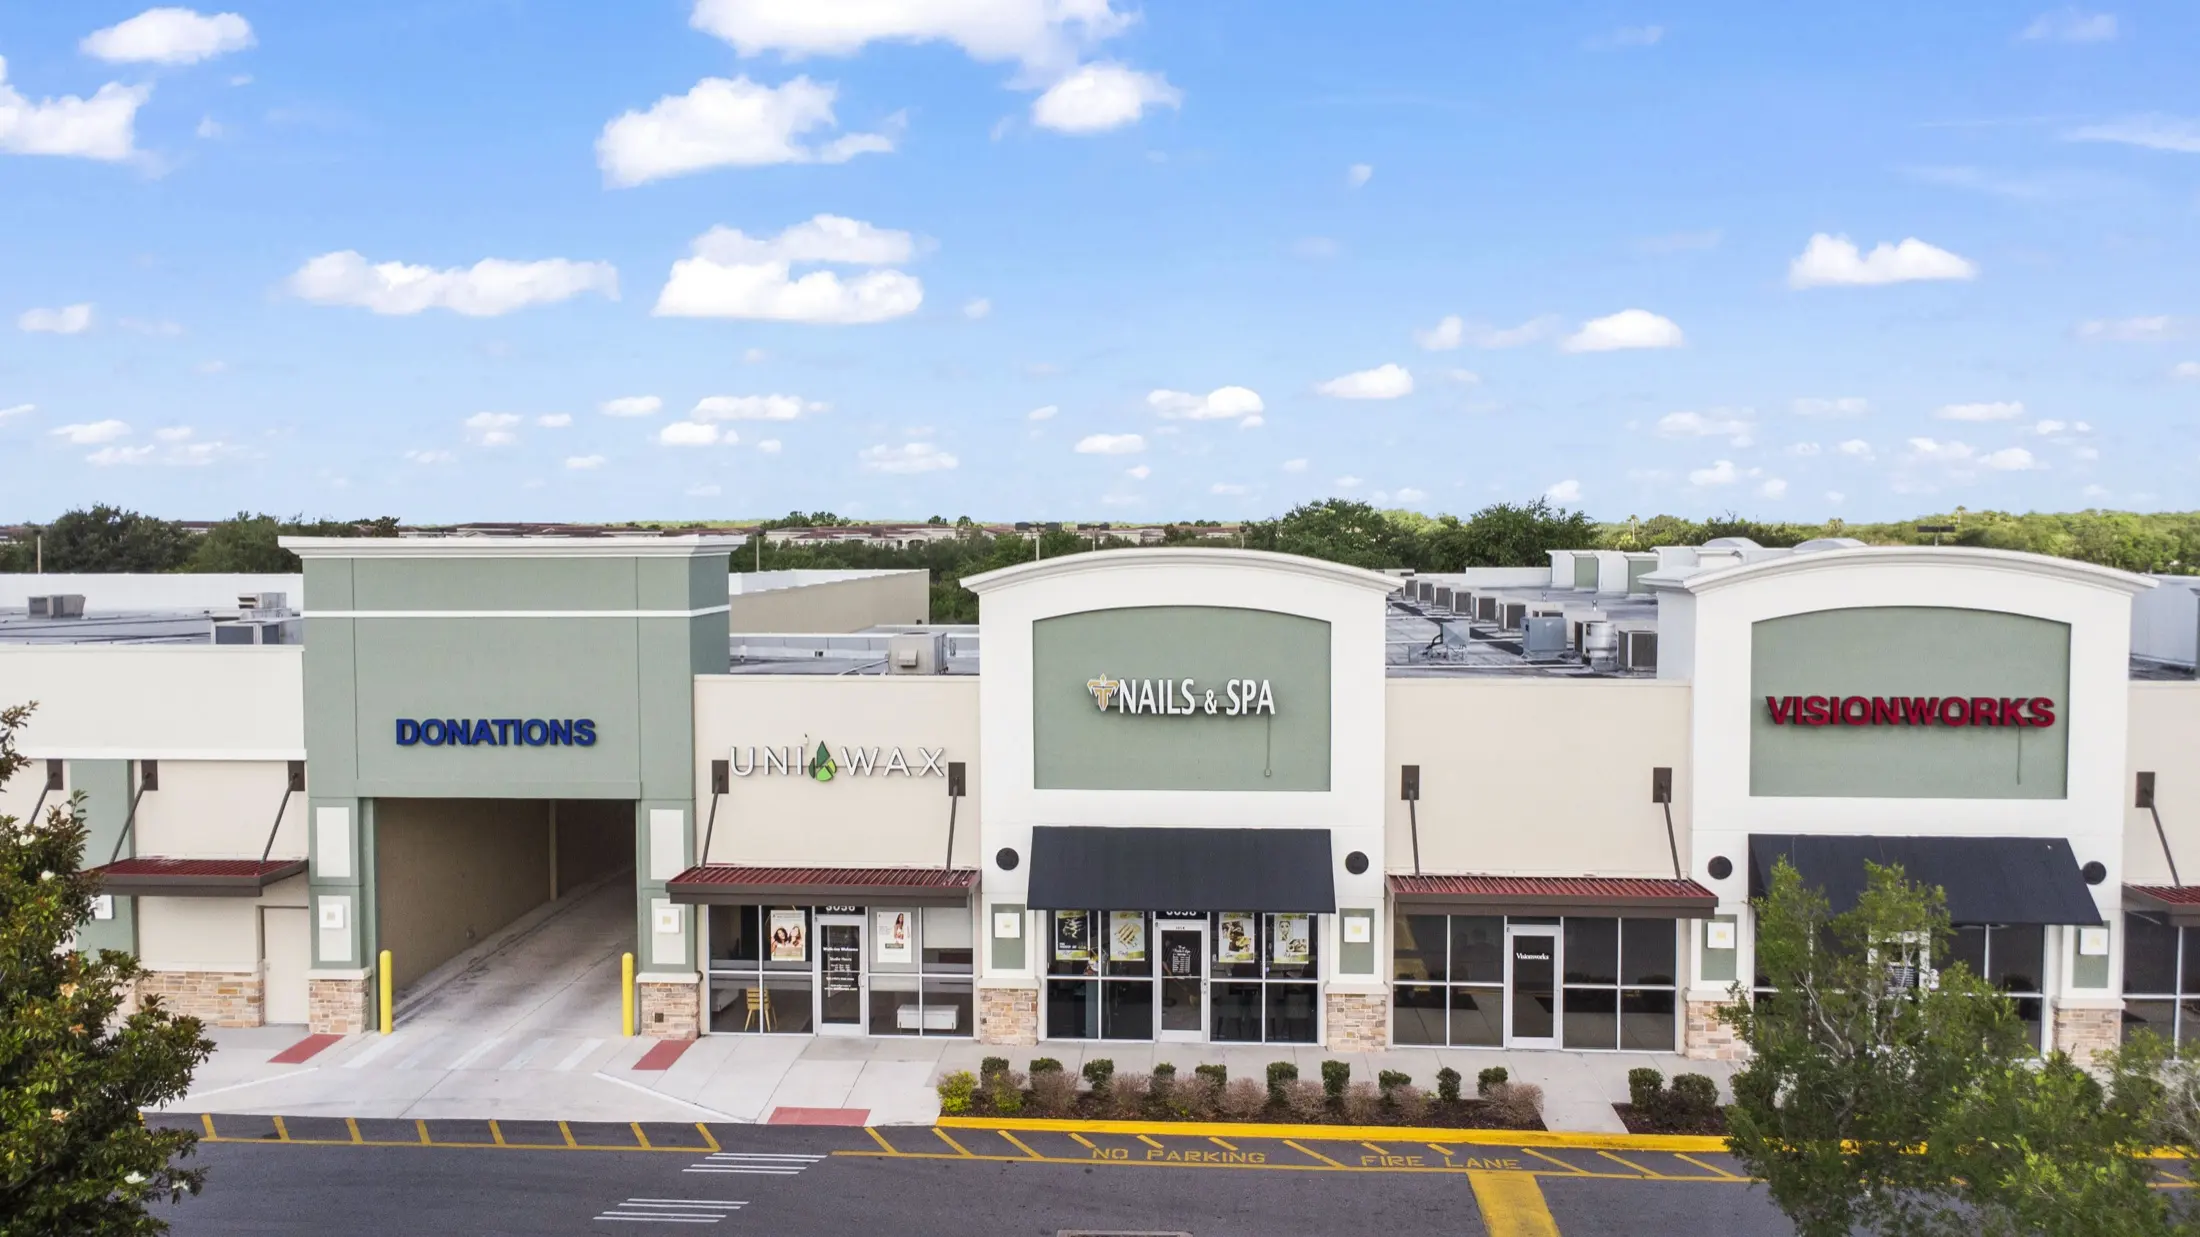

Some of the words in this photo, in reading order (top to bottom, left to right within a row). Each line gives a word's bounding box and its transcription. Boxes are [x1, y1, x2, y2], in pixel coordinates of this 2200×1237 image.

[1119, 679, 1196, 715] NAILS
[1204, 689, 1218, 715] &
[1226, 679, 1276, 715] SPA
[1765, 695, 2056, 727] VISIONWORKS
[395, 718, 597, 746] DONATIONS
[730, 746, 804, 776] UNI
[841, 746, 945, 777] WAX
[1092, 1148, 1128, 1160] NO
[1147, 1149, 1265, 1164] PARKING
[1360, 1155, 1425, 1167] FIRE
[1444, 1156, 1523, 1170] LANE
